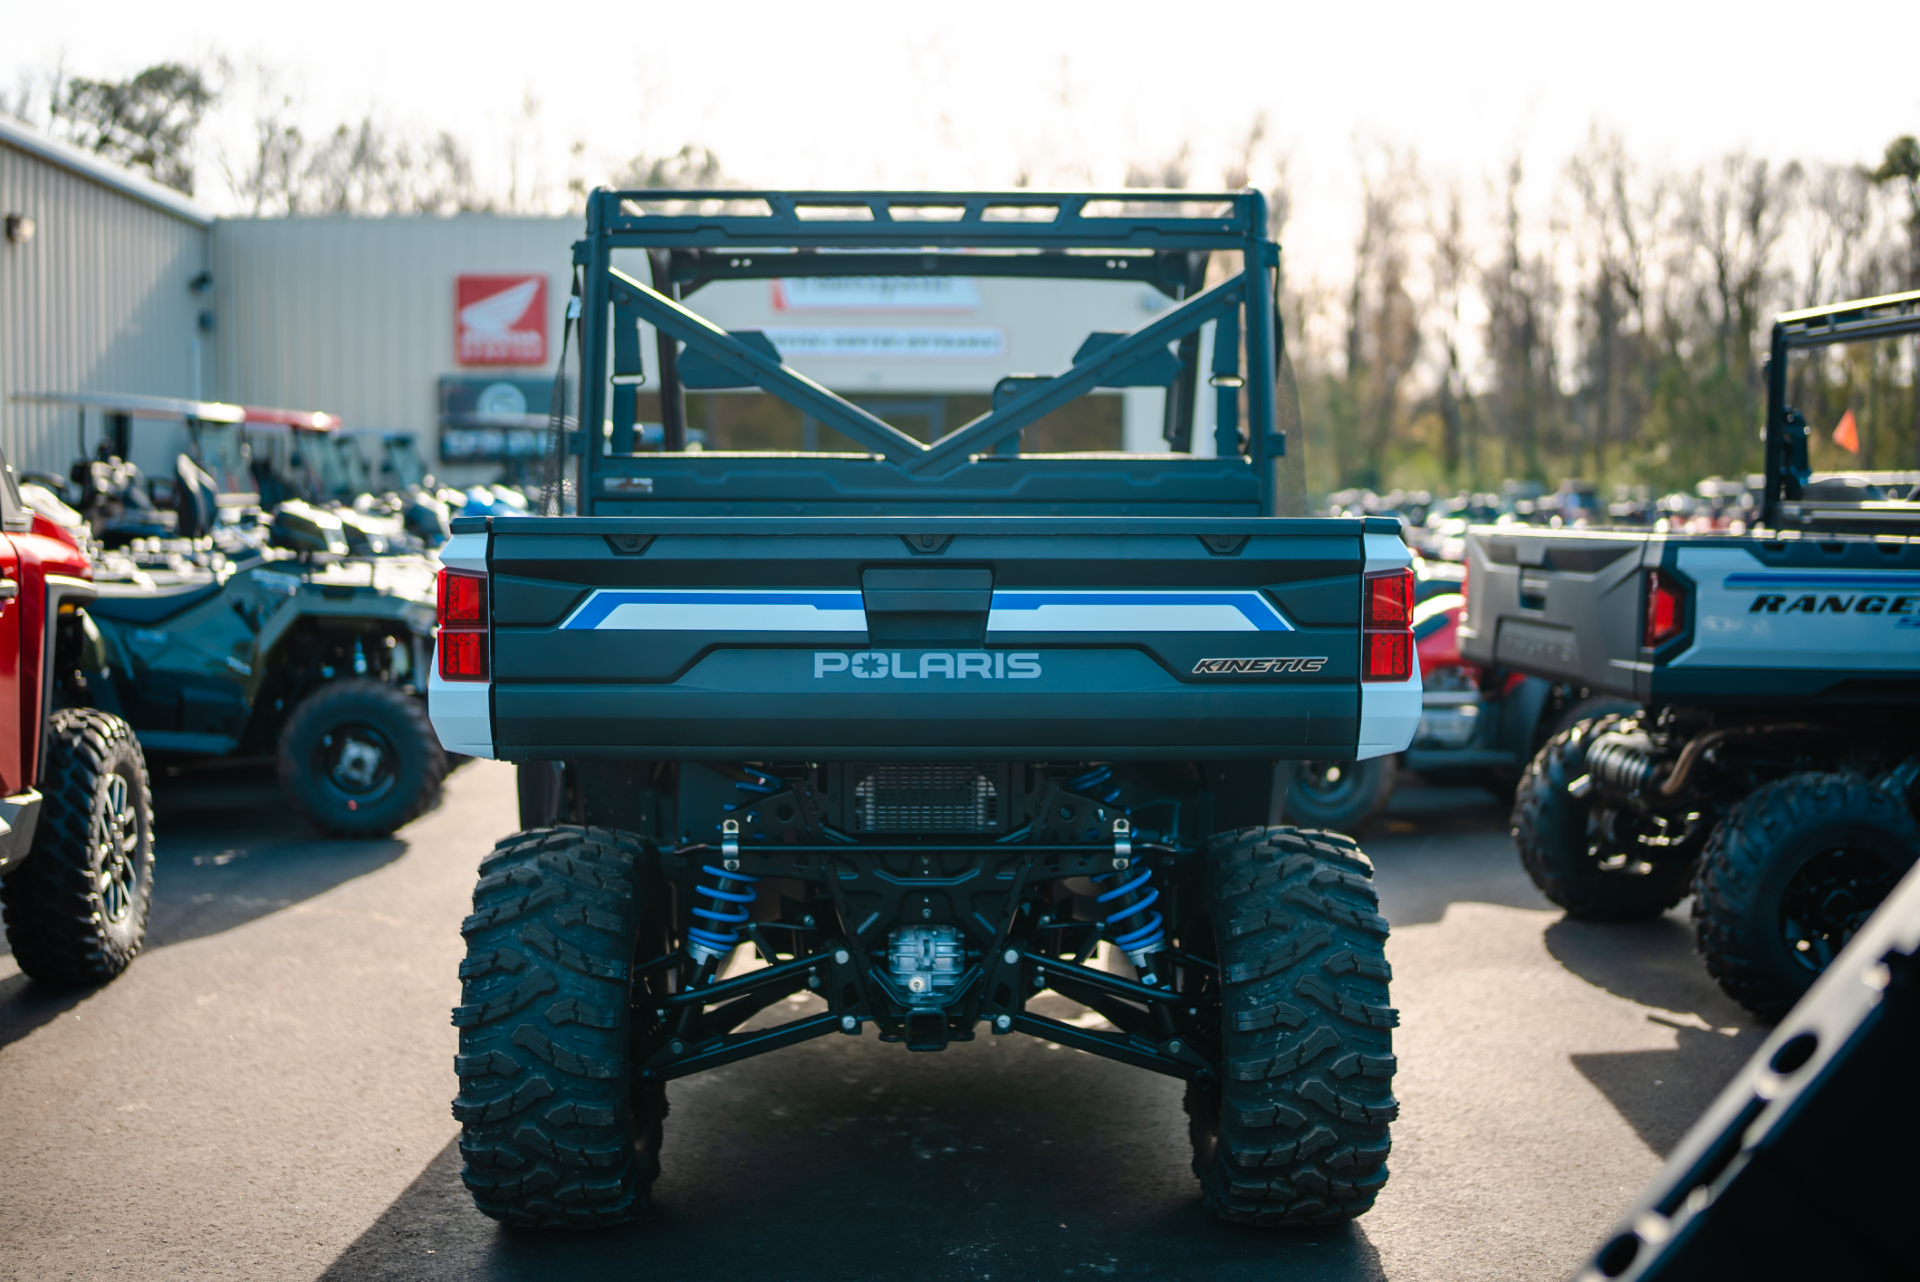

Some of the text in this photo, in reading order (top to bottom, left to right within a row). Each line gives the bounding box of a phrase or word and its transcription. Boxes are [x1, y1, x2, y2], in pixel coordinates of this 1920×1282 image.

[1749, 594, 1920, 614] RANGE
[814, 652, 1042, 679] POLARIS
[1192, 656, 1329, 674] KINETIC
